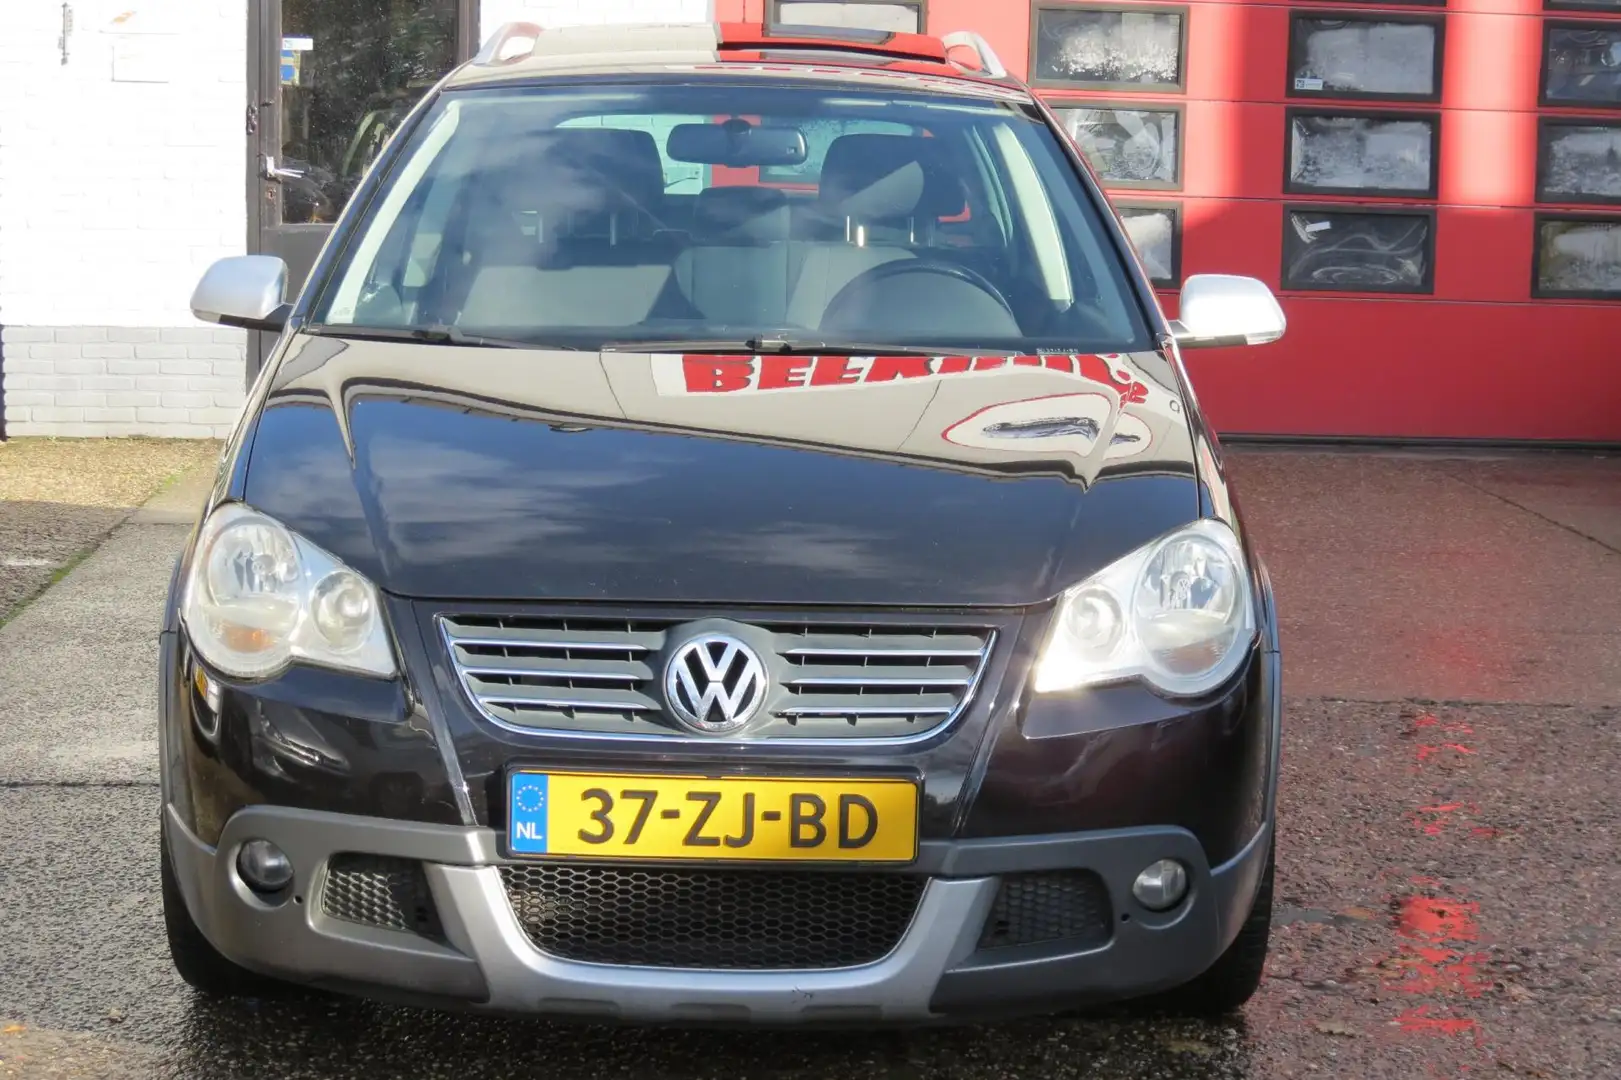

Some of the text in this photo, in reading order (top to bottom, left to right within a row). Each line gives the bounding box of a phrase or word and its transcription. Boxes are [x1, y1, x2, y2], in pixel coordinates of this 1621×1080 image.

[667, 634, 767, 731] VW
[516, 821, 543, 840] NL
[577, 787, 879, 850] 37-ZJ-BD
